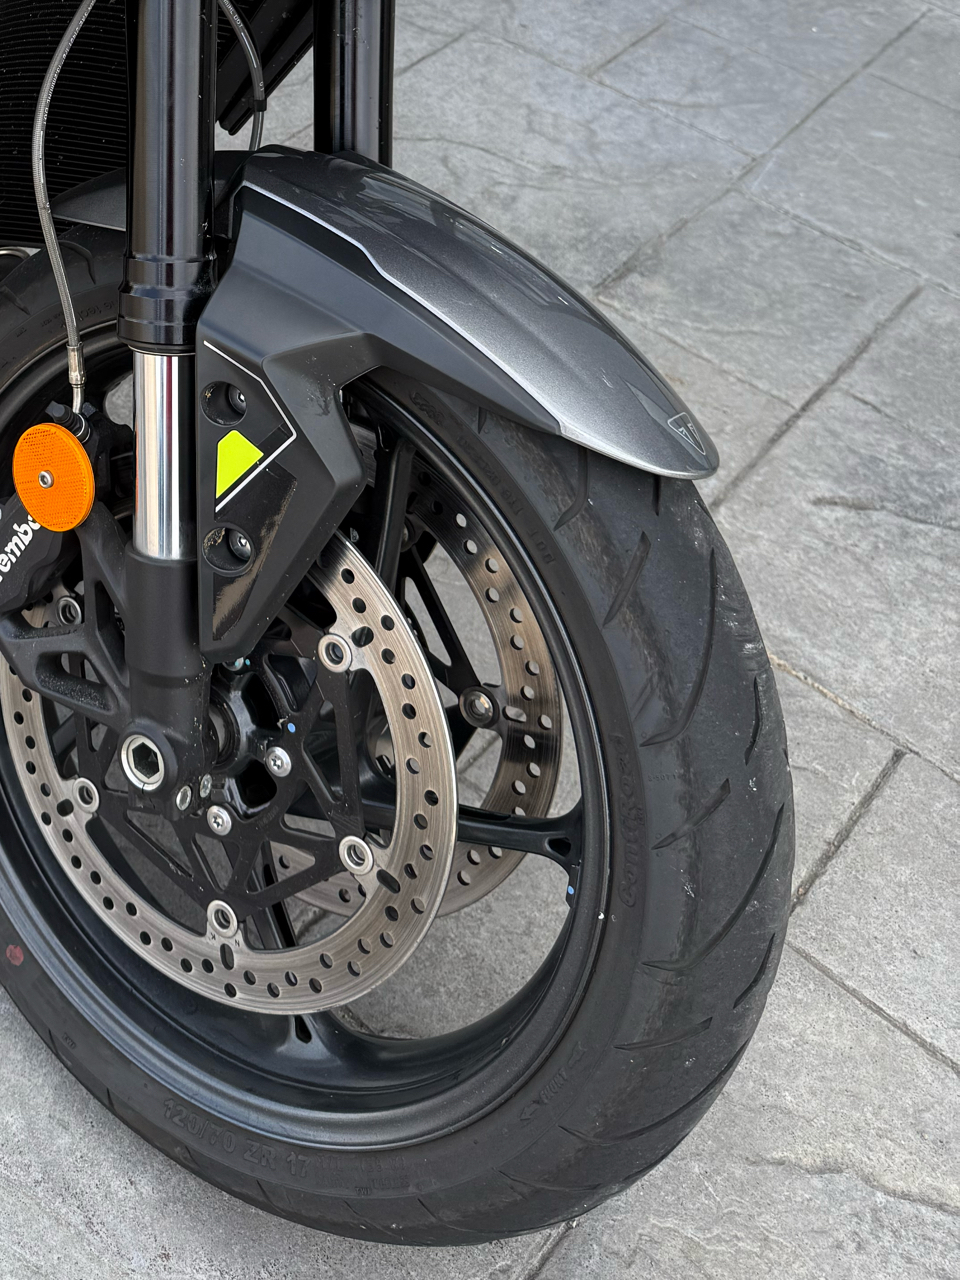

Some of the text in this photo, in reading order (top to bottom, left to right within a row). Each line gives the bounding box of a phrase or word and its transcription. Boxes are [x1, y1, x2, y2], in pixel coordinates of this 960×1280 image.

[164, 1097, 237, 1153] 120/70
[243, 1138, 276, 1170] ZR
[286, 1151, 312, 1177] 17
